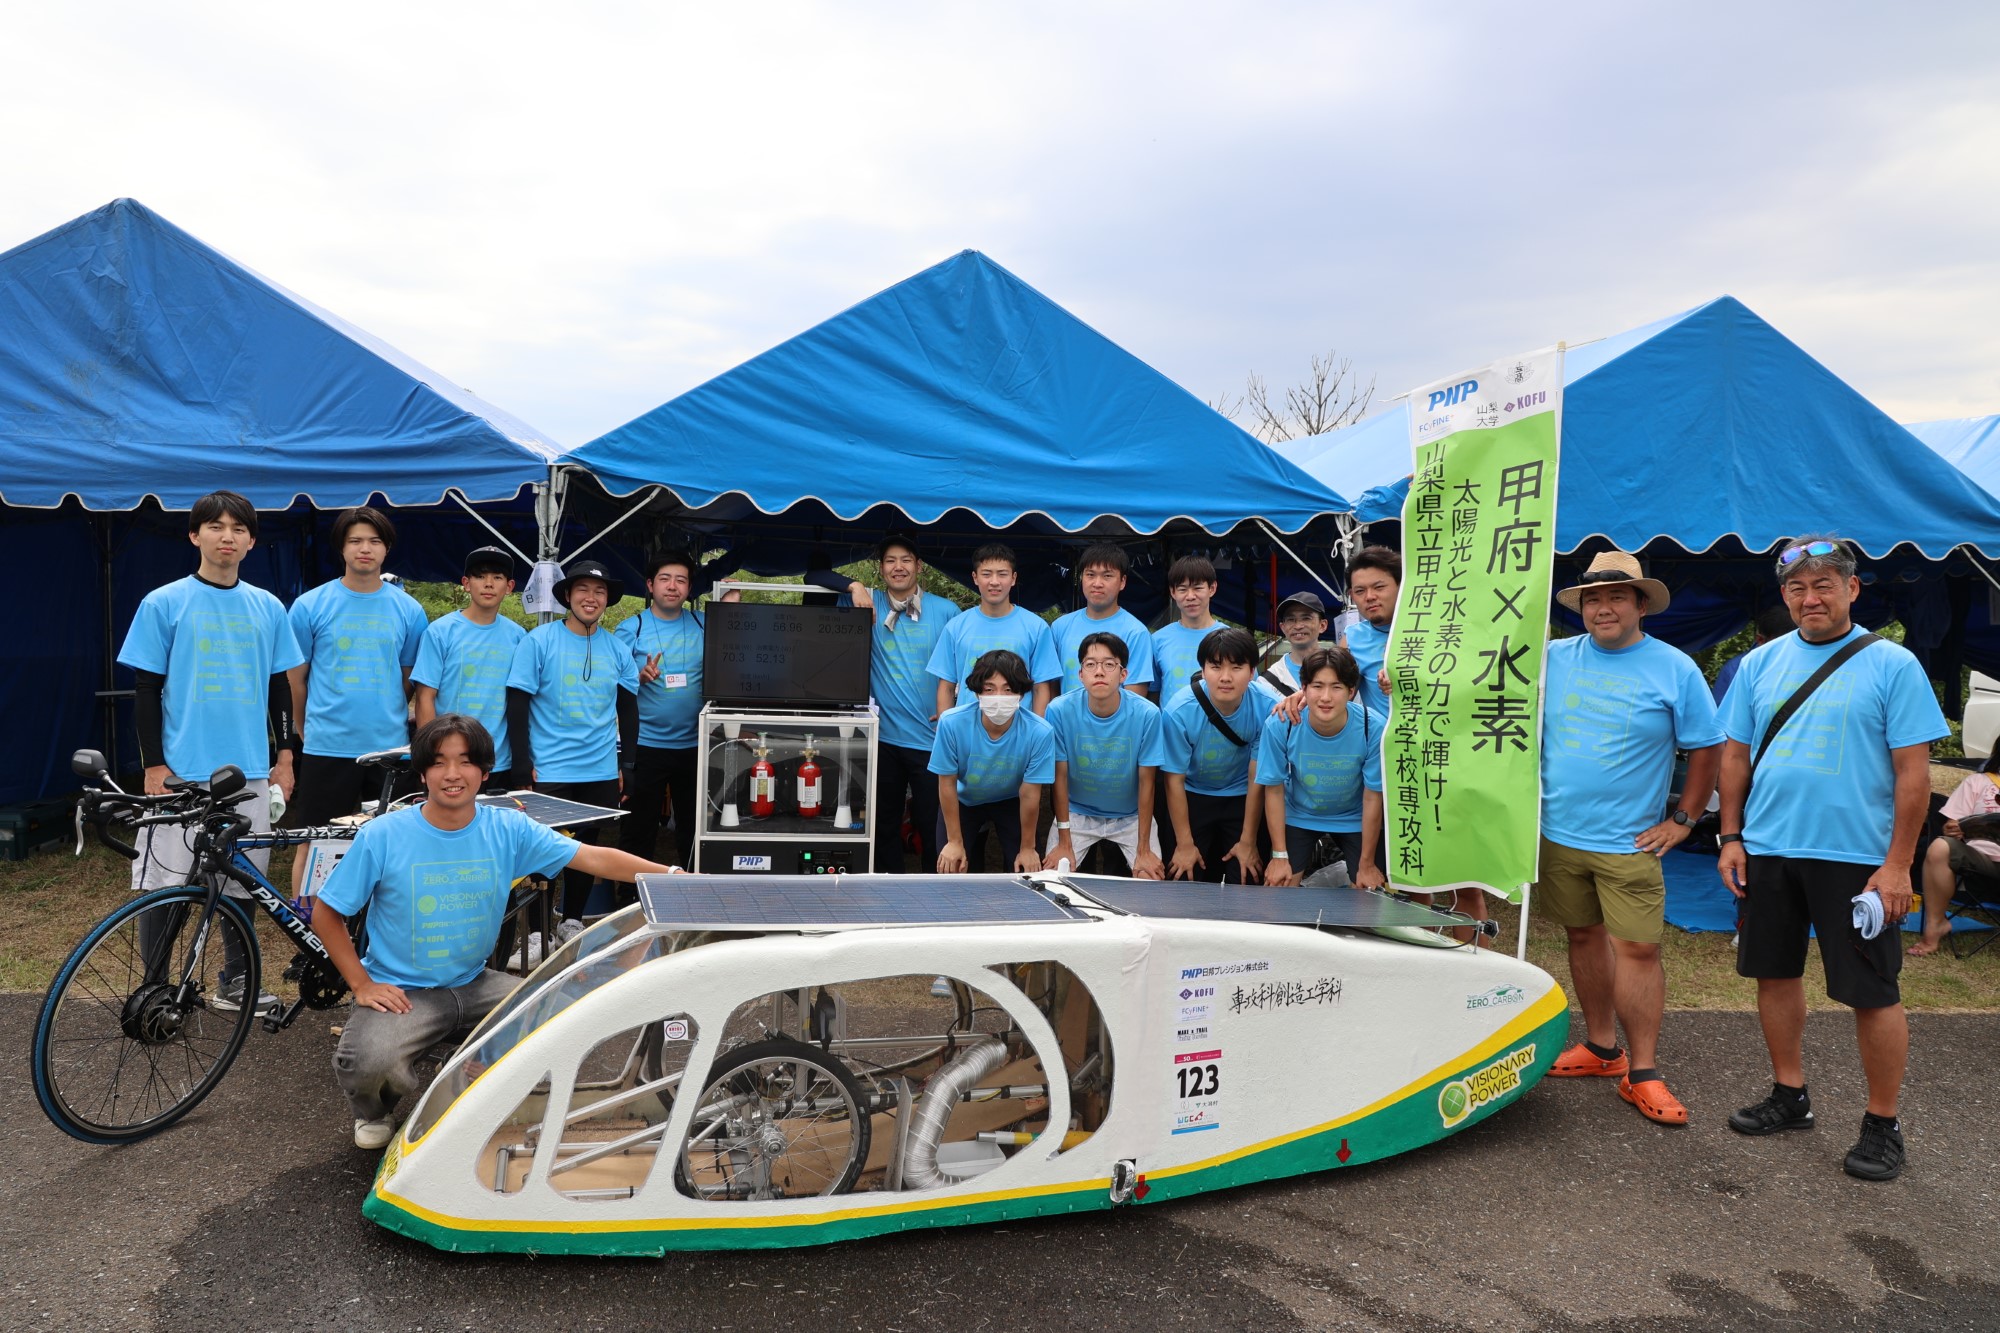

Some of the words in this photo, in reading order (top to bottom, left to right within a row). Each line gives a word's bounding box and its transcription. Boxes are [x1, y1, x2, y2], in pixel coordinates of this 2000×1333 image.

[1428, 380, 1479, 412] PNP
[1517, 391, 1546, 410] KOFU
[1477, 416, 1499, 428] 大学
[1395, 443, 1446, 877] 山梨県立甲府工業高等学校専攻科
[738, 856, 763, 866] PNP
[439, 889, 493, 903] VISIONARY
[439, 900, 478, 911] POWER
[1181, 967, 1202, 979] PNP
[1194, 987, 1214, 998] KOFU
[1466, 1048, 1535, 1091] VISIONARY
[1177, 1063, 1219, 1099] 123
[1469, 1072, 1519, 1108] POWER
